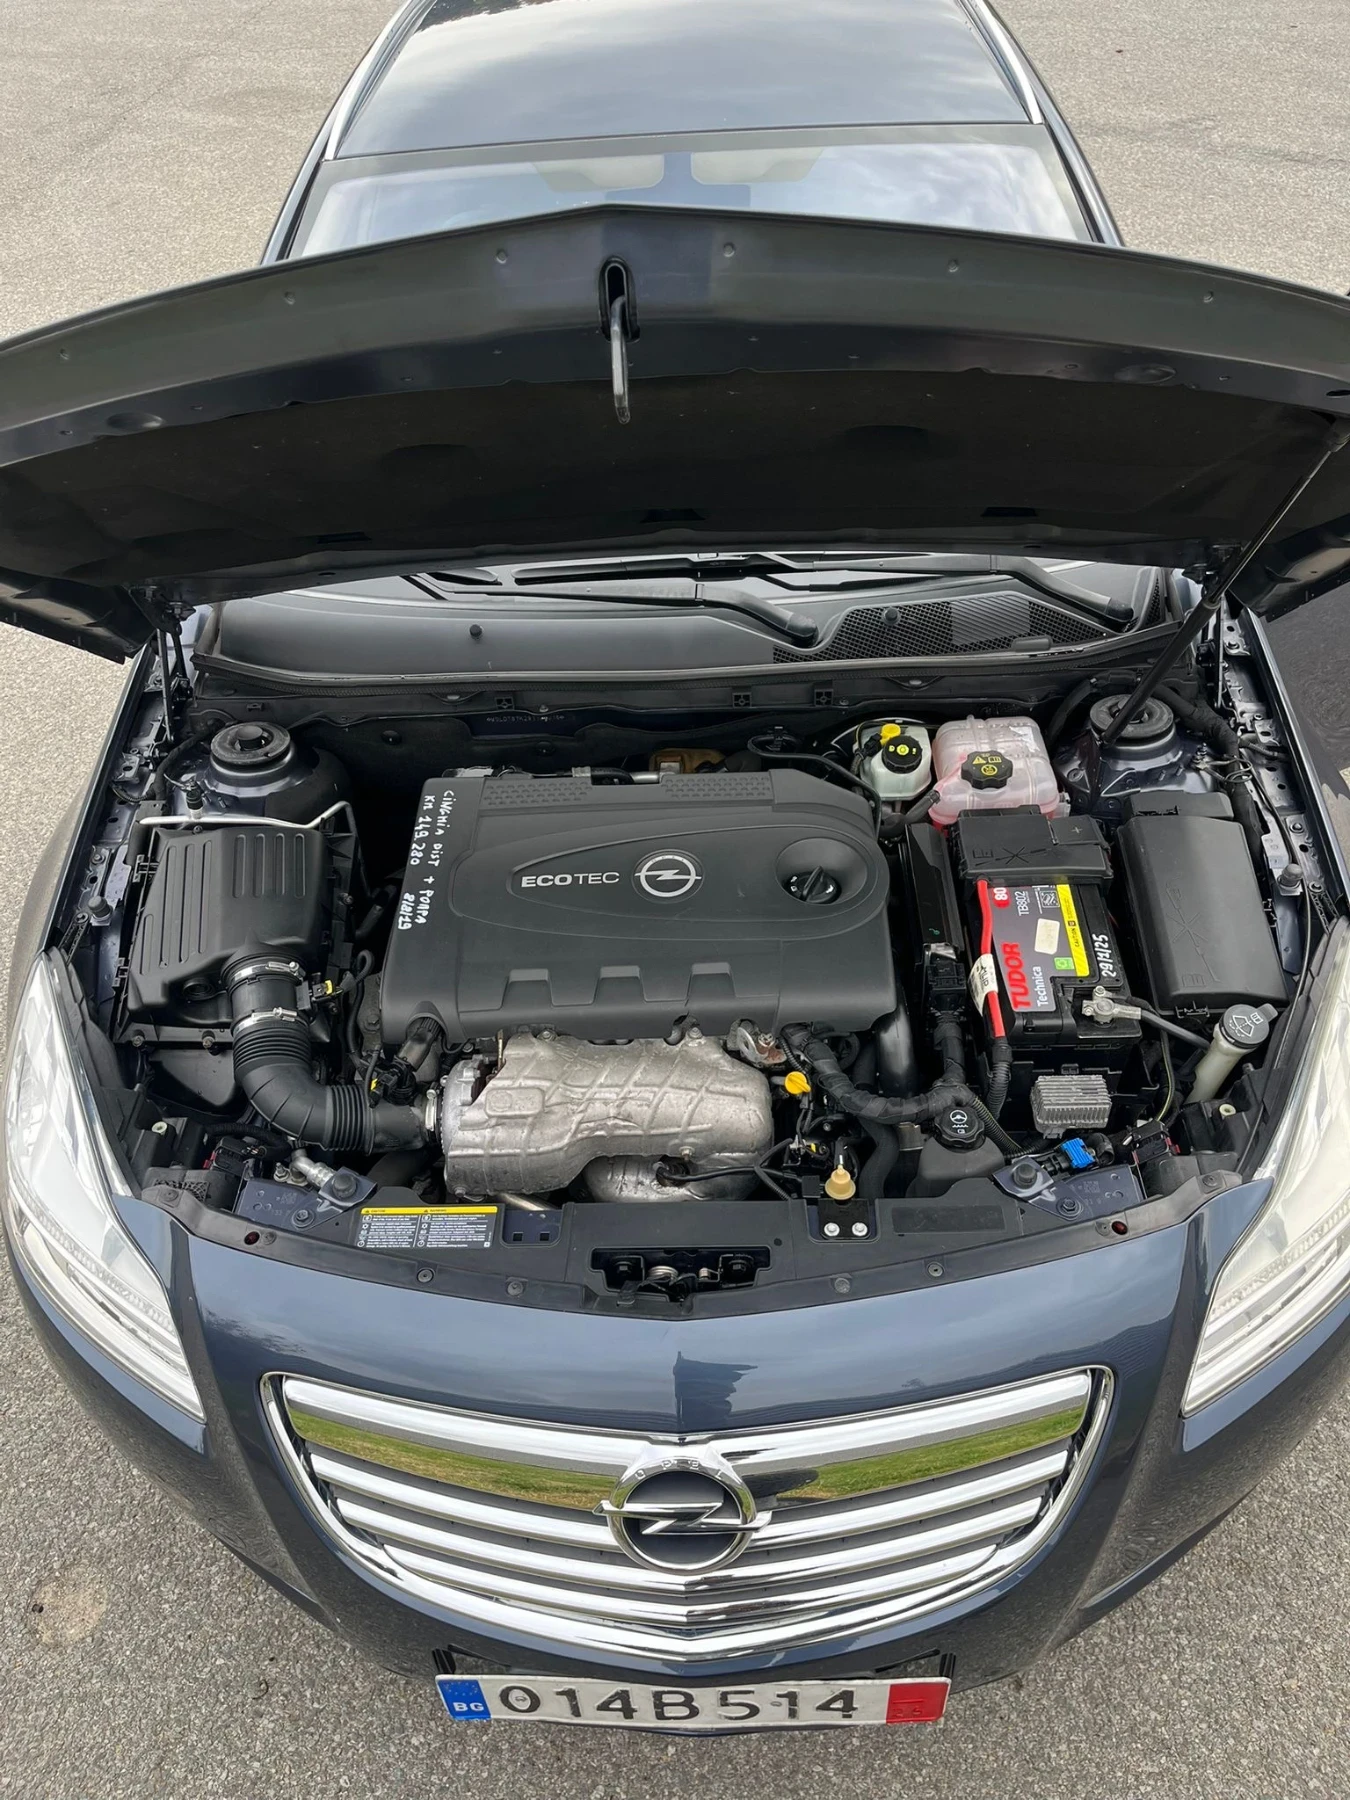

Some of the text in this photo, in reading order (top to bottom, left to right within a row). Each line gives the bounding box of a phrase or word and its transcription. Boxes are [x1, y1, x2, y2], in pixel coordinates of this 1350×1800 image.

[521, 872, 620, 887] ECOTEC
[993, 887, 1008, 901] 80
[1014, 890, 1030, 917] TB802
[1001, 942, 1032, 1010] TUDOR
[1032, 966, 1050, 1007] Technica
[453, 1702, 484, 1712] BG
